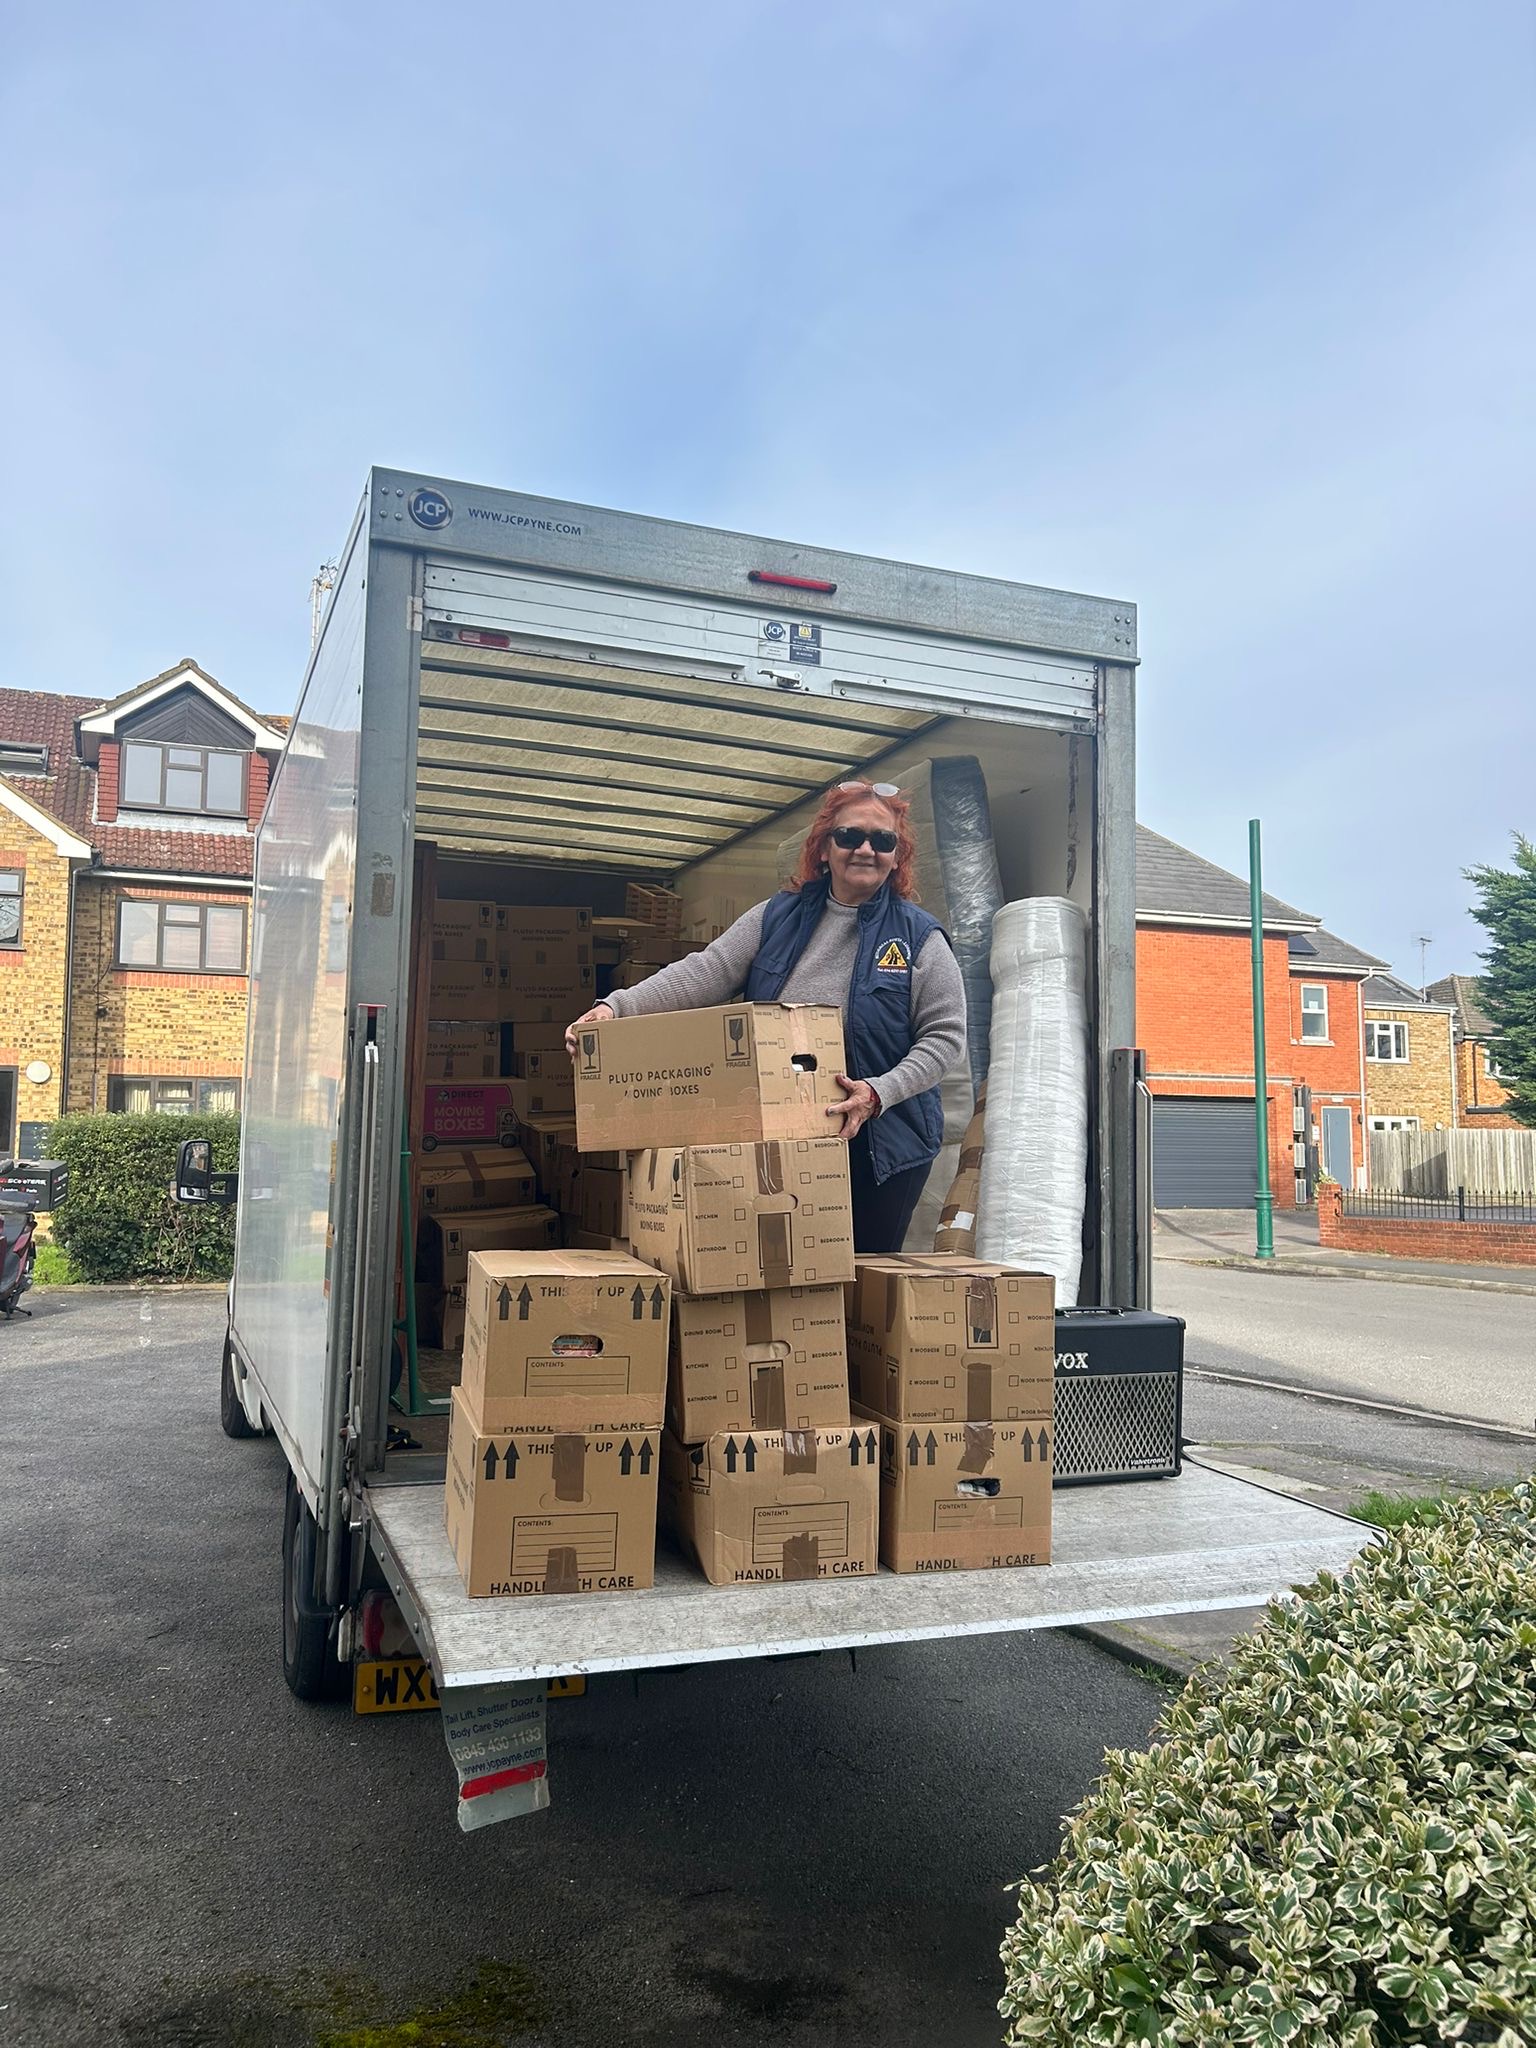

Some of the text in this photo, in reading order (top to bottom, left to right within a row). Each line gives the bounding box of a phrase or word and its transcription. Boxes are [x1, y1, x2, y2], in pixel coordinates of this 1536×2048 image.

[415, 500, 446, 517] JCP
[468, 508, 582, 536] WWW.JCPAYNE.COM
[768, 626, 782, 634] JCP
[726, 1060, 751, 1068] FRAGILE
[608, 1066, 712, 1084] PLUTO PACKAGING
[624, 1087, 663, 1099] OVING
[434, 1106, 485, 1117] MOVING
[434, 1118, 485, 1131] BOXES
[646, 1204, 668, 1215] PACKAGING
[640, 1220, 665, 1232] MOVING BOXES
[608, 1287, 625, 1297] UP
[1054, 1352, 1088, 1369] VOX
[764, 1438, 783, 1448] THI
[826, 1435, 842, 1445] UP
[1001, 1432, 1015, 1441] UP
[596, 1442, 613, 1453] UP
[916, 1558, 957, 1571] HANDL
[1006, 1554, 1036, 1565] CARE
[735, 1568, 781, 1581] HANDL
[833, 1561, 864, 1574] CARE
[598, 1576, 634, 1588] CARE
[446, 1695, 542, 1724] Tail Lift, Shutter Door &
[450, 1711, 540, 1740] Body Care Specialists
[455, 1727, 542, 1761] 0845 430 1133
[463, 1747, 543, 1775] www.jcpayne.com
